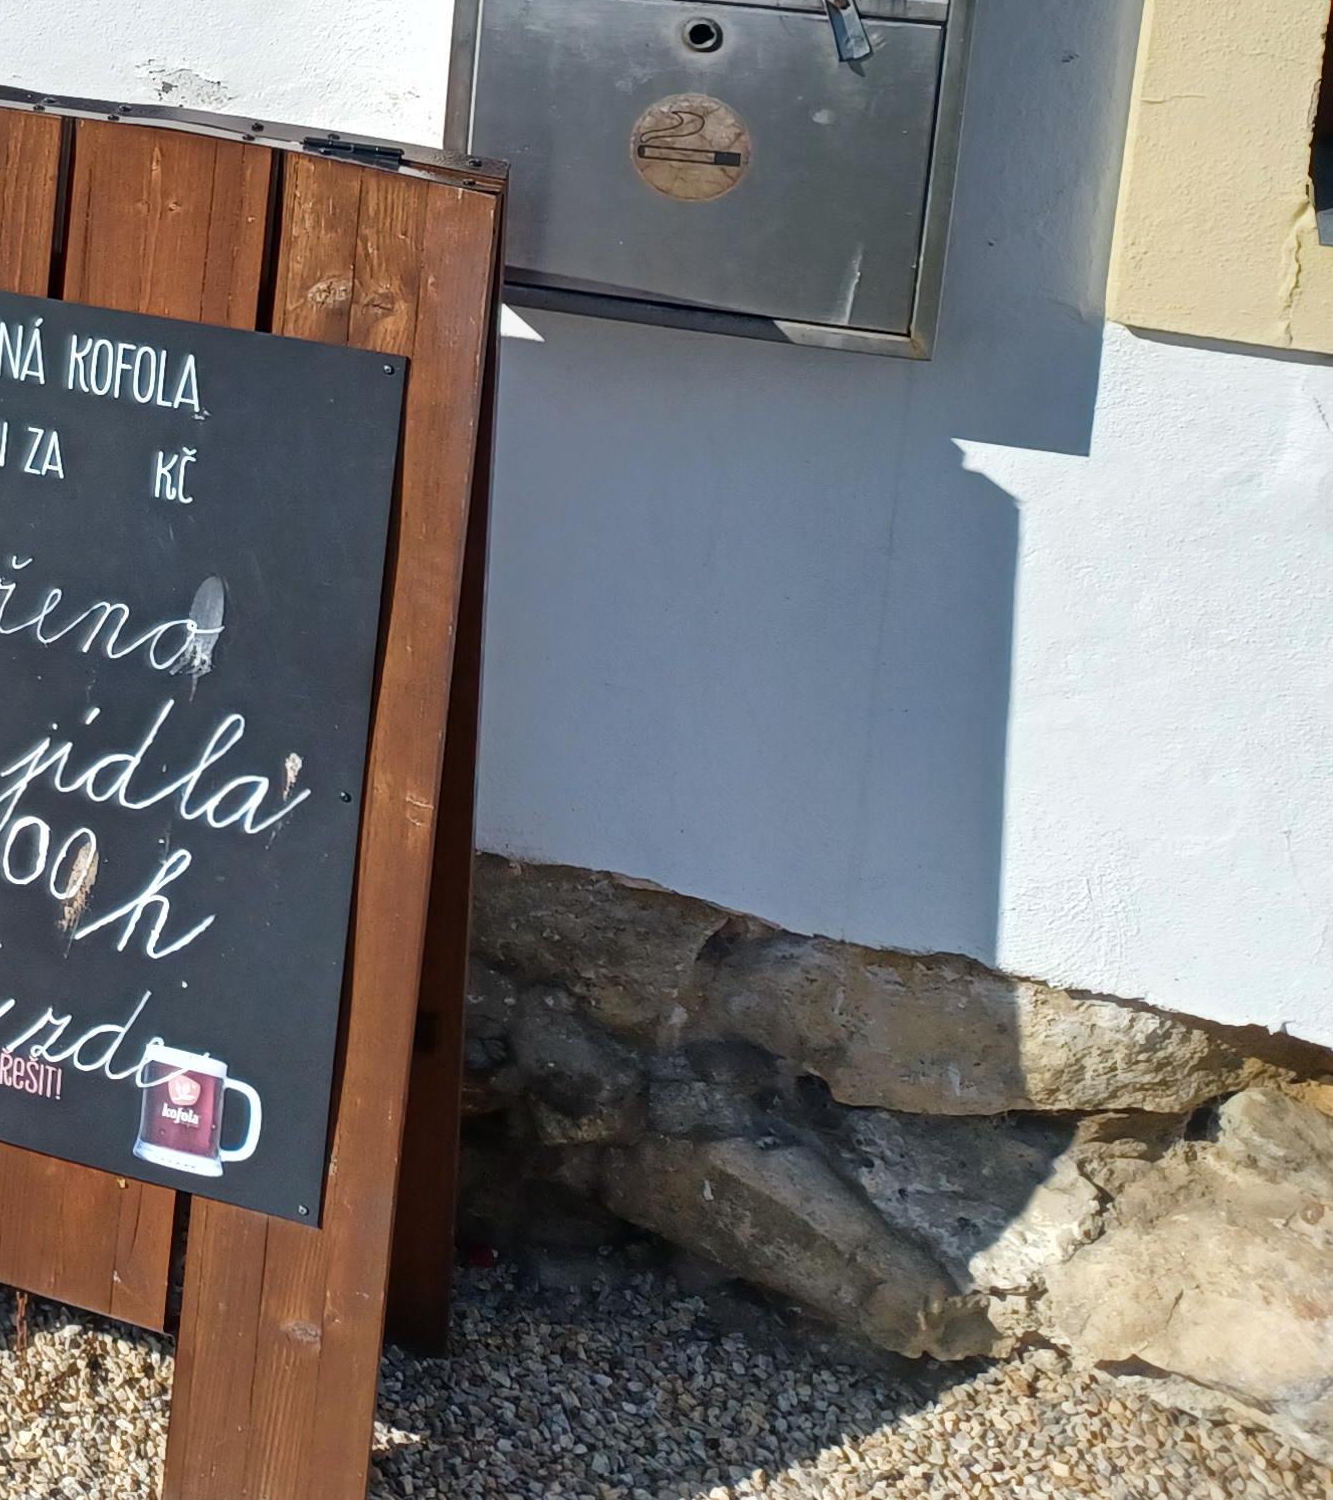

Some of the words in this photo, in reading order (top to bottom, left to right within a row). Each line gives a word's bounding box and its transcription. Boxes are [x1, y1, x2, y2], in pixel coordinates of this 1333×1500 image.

[68, 334, 201, 412] KOFOLA
[23, 426, 65, 479] ZA
[154, 446, 197, 504] KČ
[75, 849, 216, 959] h
[162, 1102, 200, 1125] kofola
